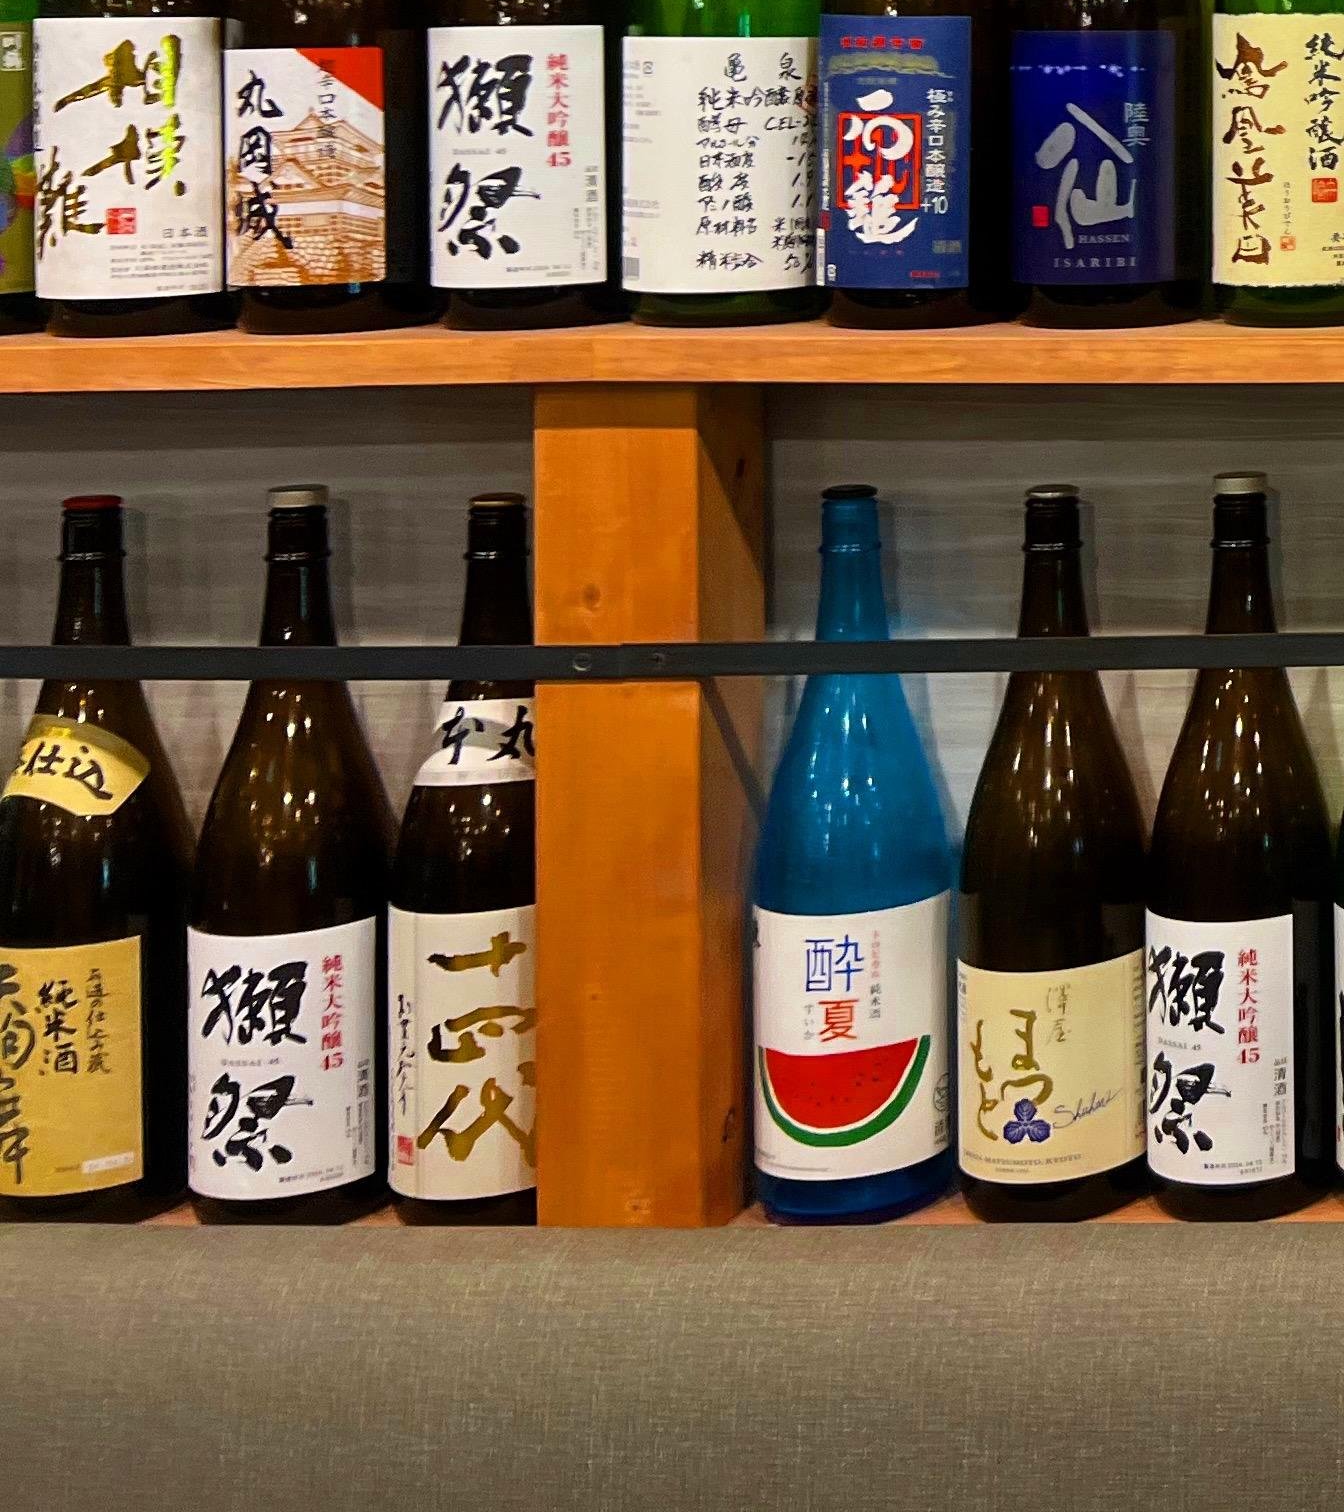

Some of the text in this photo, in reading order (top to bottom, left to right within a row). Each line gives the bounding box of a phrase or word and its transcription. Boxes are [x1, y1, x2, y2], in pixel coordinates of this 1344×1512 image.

[234, 69, 294, 250] 丸岡城
[436, 54, 541, 261] 獺祭
[545, 53, 572, 168] 純米大吟醸45
[1122, 101, 1151, 146] 陸奥
[1034, 102, 1135, 250] 八仙
[162, 226, 209, 239] 日本酒
[1053, 256, 1138, 269] ISARIBI
[1077, 233, 1130, 244] HASSEN
[15, 740, 114, 801] 仕込
[34, 979, 80, 1076] 純米酒
[320, 954, 345, 1071] 純米大吟醸45
[804, 933, 865, 1043] 酔夏
[1236, 948, 1261, 1066] 純米大吟醸45
[201, 961, 314, 1172] 獺祭
[1148, 945, 1232, 1155] 獺祭
[1273, 1067, 1287, 1098] 清酒
